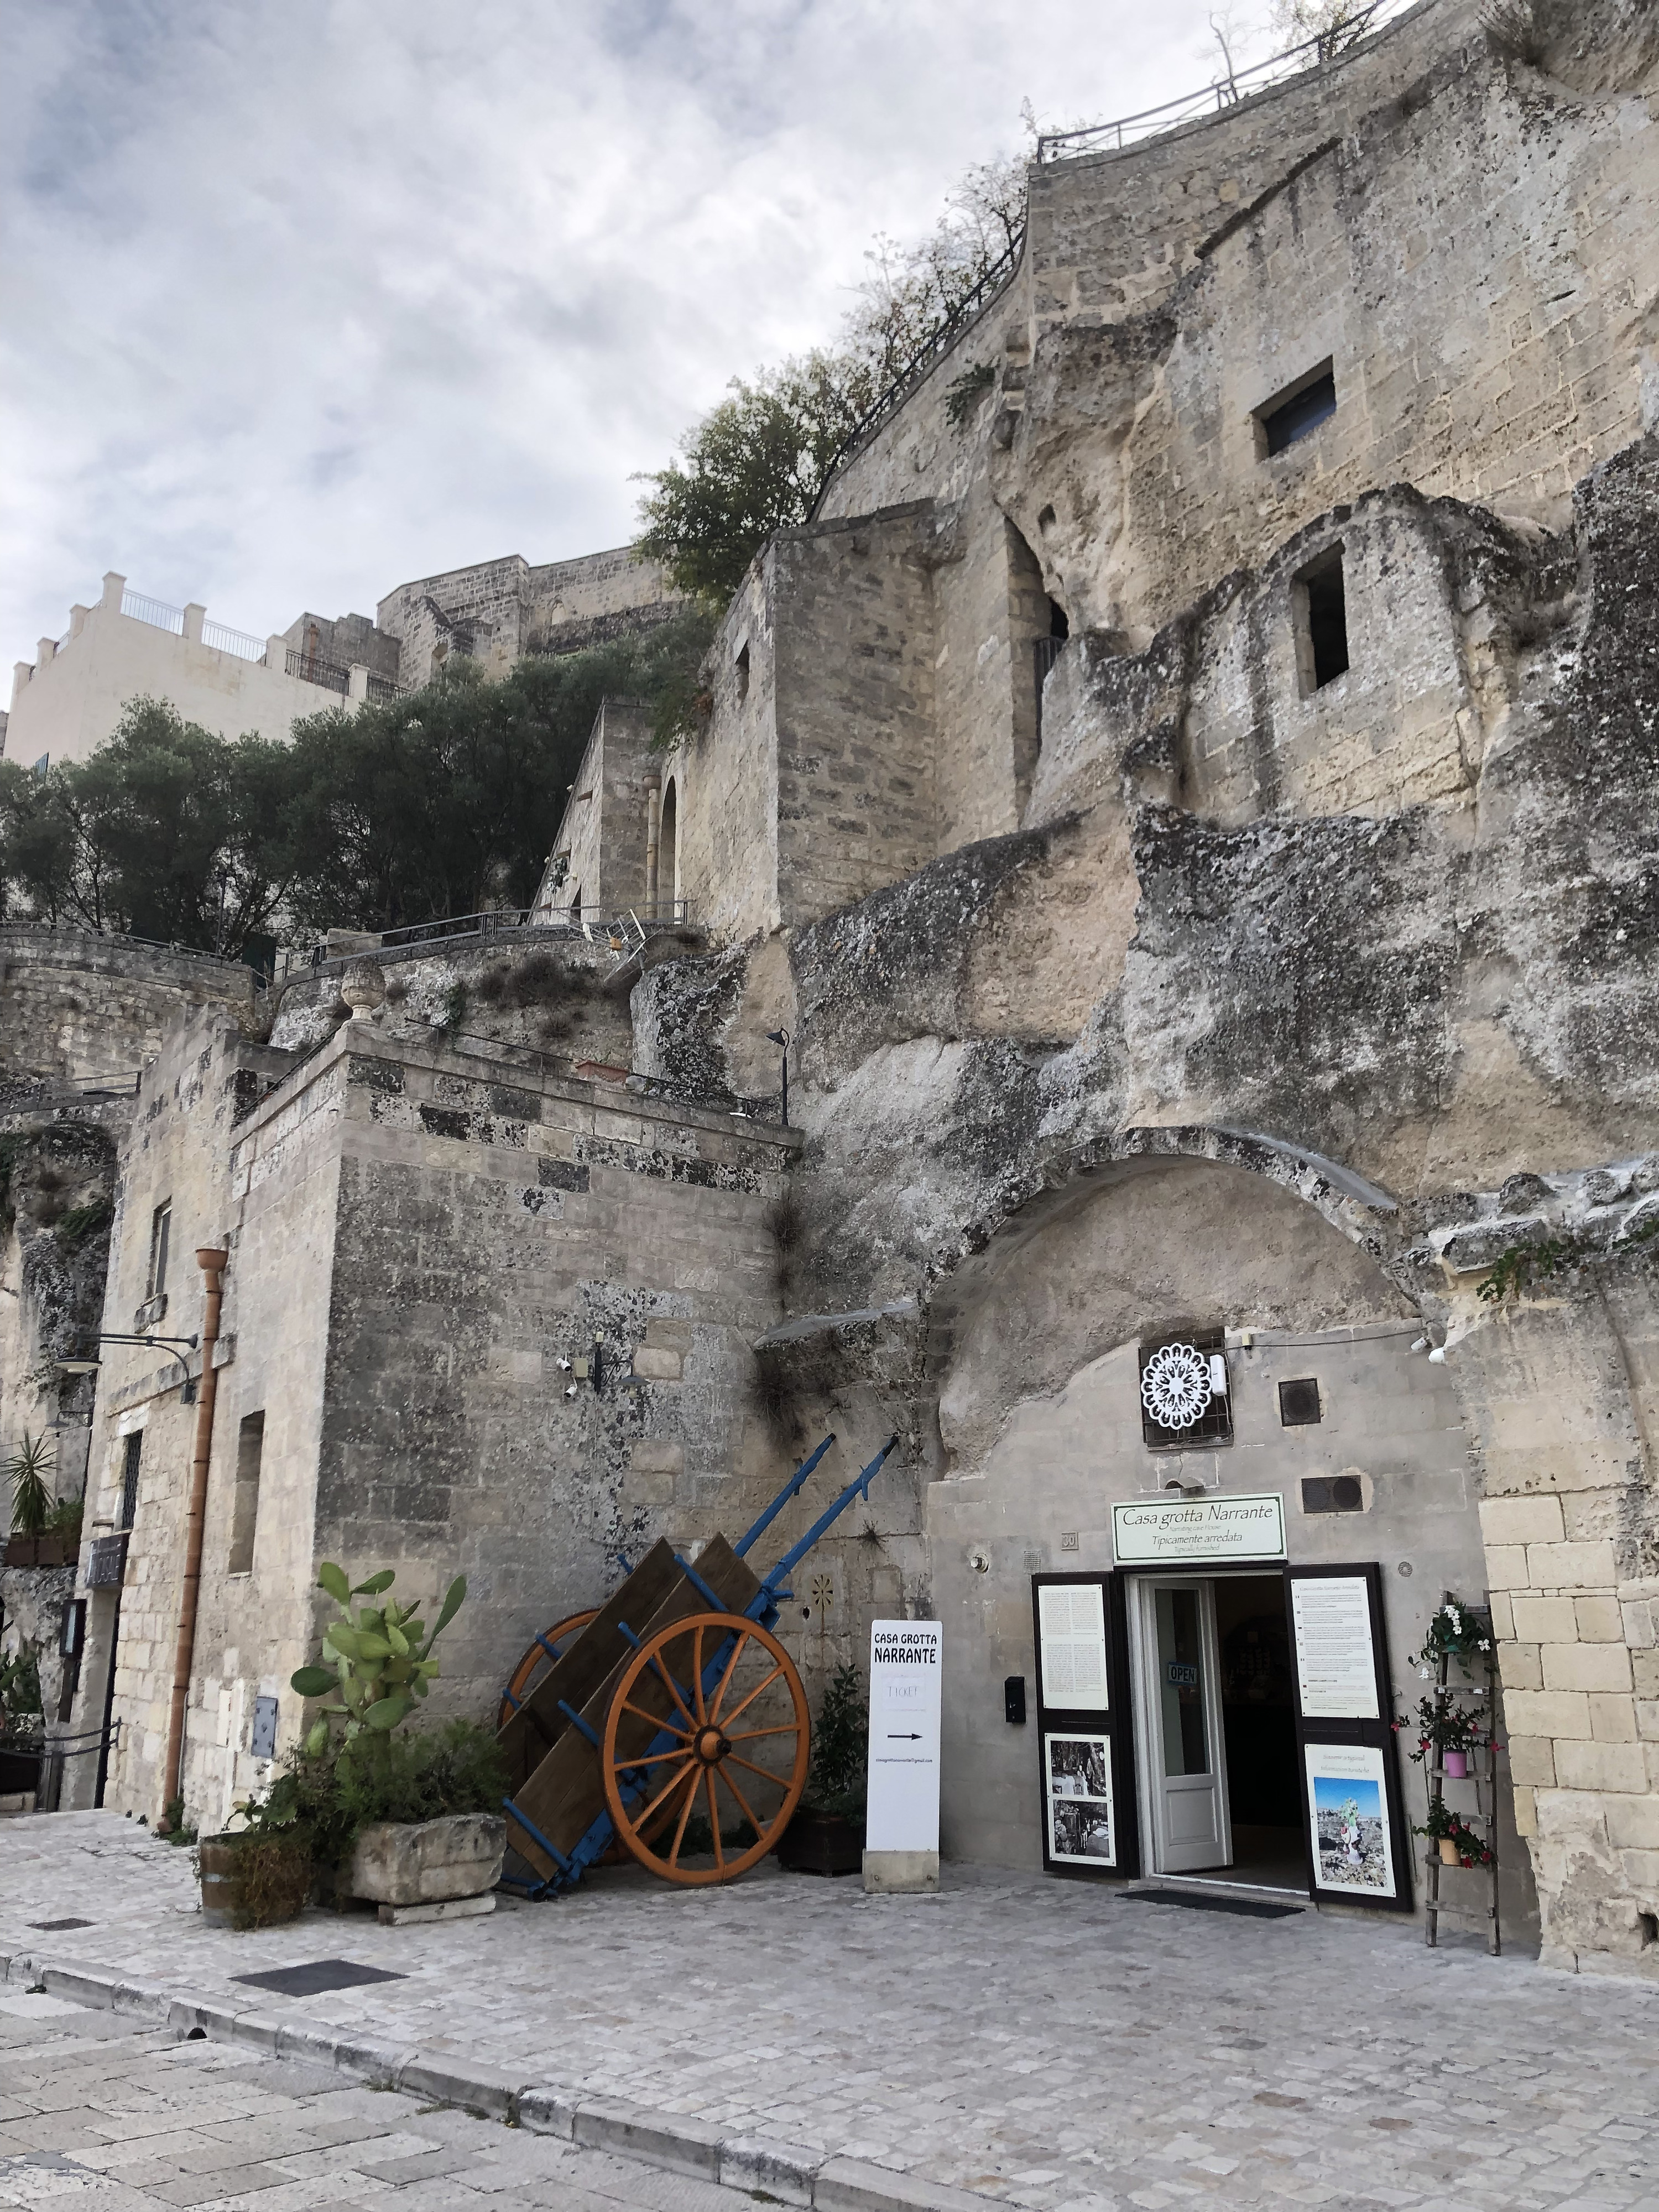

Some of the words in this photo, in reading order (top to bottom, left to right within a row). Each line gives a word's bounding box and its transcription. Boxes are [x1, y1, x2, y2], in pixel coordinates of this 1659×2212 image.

[1123, 1509, 1157, 1526] Casa
[1159, 1509, 1203, 1530] grotta
[1208, 1505, 1273, 1521] Narrante
[1062, 1535, 1076, 1547] 30
[1152, 1535, 1203, 1550] Tipicamente
[1204, 1530, 1243, 1543] arredata
[874, 1633, 898, 1644] CASA
[901, 1634, 937, 1645] GROTTA
[874, 1647, 936, 1664] NARRANTE
[1171, 1666, 1194, 1682] OPEN
